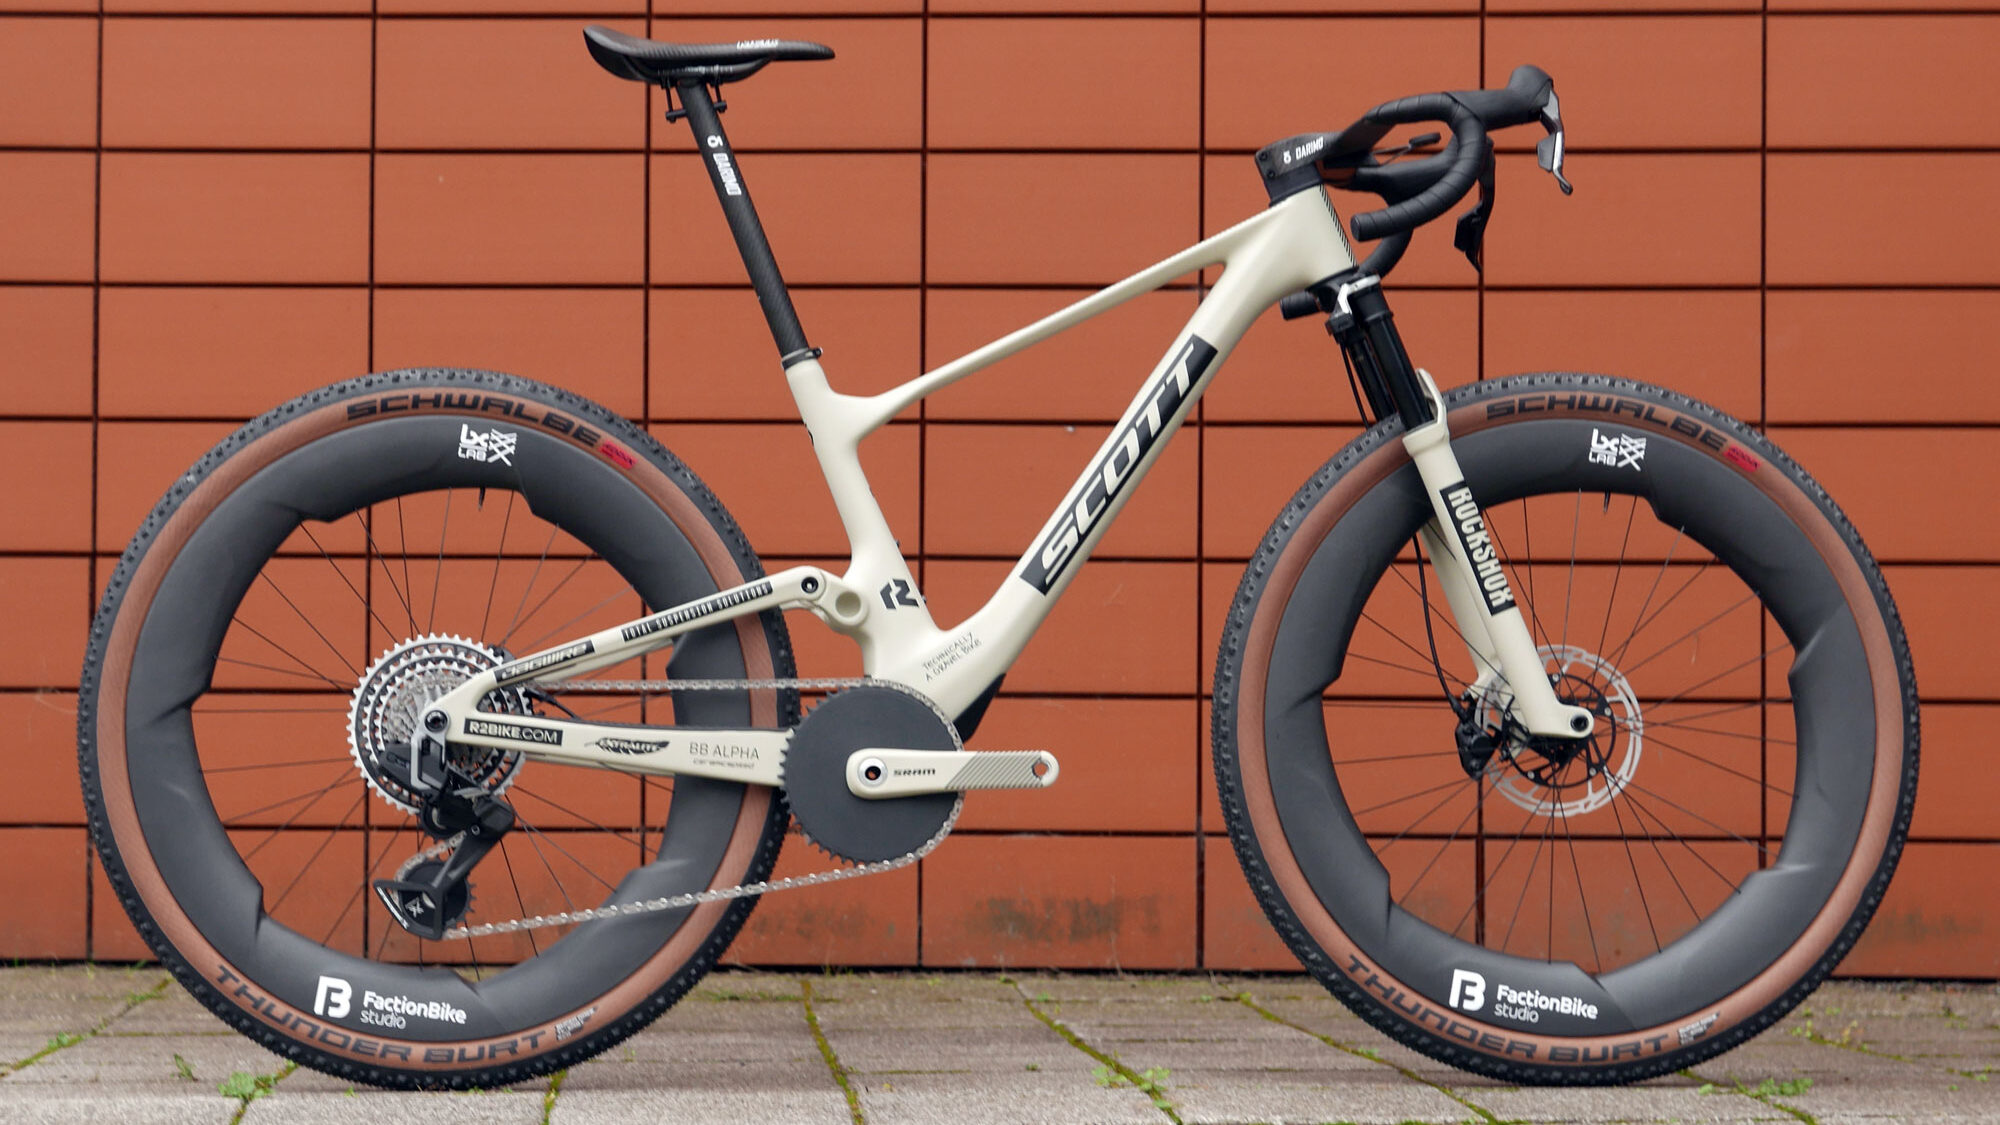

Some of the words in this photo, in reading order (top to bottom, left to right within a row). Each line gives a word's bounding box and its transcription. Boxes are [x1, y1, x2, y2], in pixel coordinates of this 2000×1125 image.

[1295, 136, 1324, 161] DARIMO
[346, 392, 602, 448] SCHWALBE
[1486, 394, 1729, 451] SCHWALBE
[1041, 342, 1195, 586] SCOTT
[1447, 486, 1515, 608] ROCKSHOX
[624, 625, 652, 641] TOTAL
[655, 602, 714, 630] SUSPENSION
[716, 583, 769, 610] SOLUTIONS
[469, 720, 558, 744] R2BIKE.COM
[689, 741, 709, 756] BB
[712, 743, 760, 761] ALPHA
[215, 964, 411, 1062] THUNDER
[423, 1030, 547, 1064] BURT
[359, 1008, 407, 1030] studio
[362, 990, 468, 1025] FactionBike
[1347, 954, 1537, 1060] THUNDER
[1547, 1033, 1669, 1063] BURT
[1493, 1002, 1540, 1024] studio
[1496, 983, 1599, 1020] FactionBike
